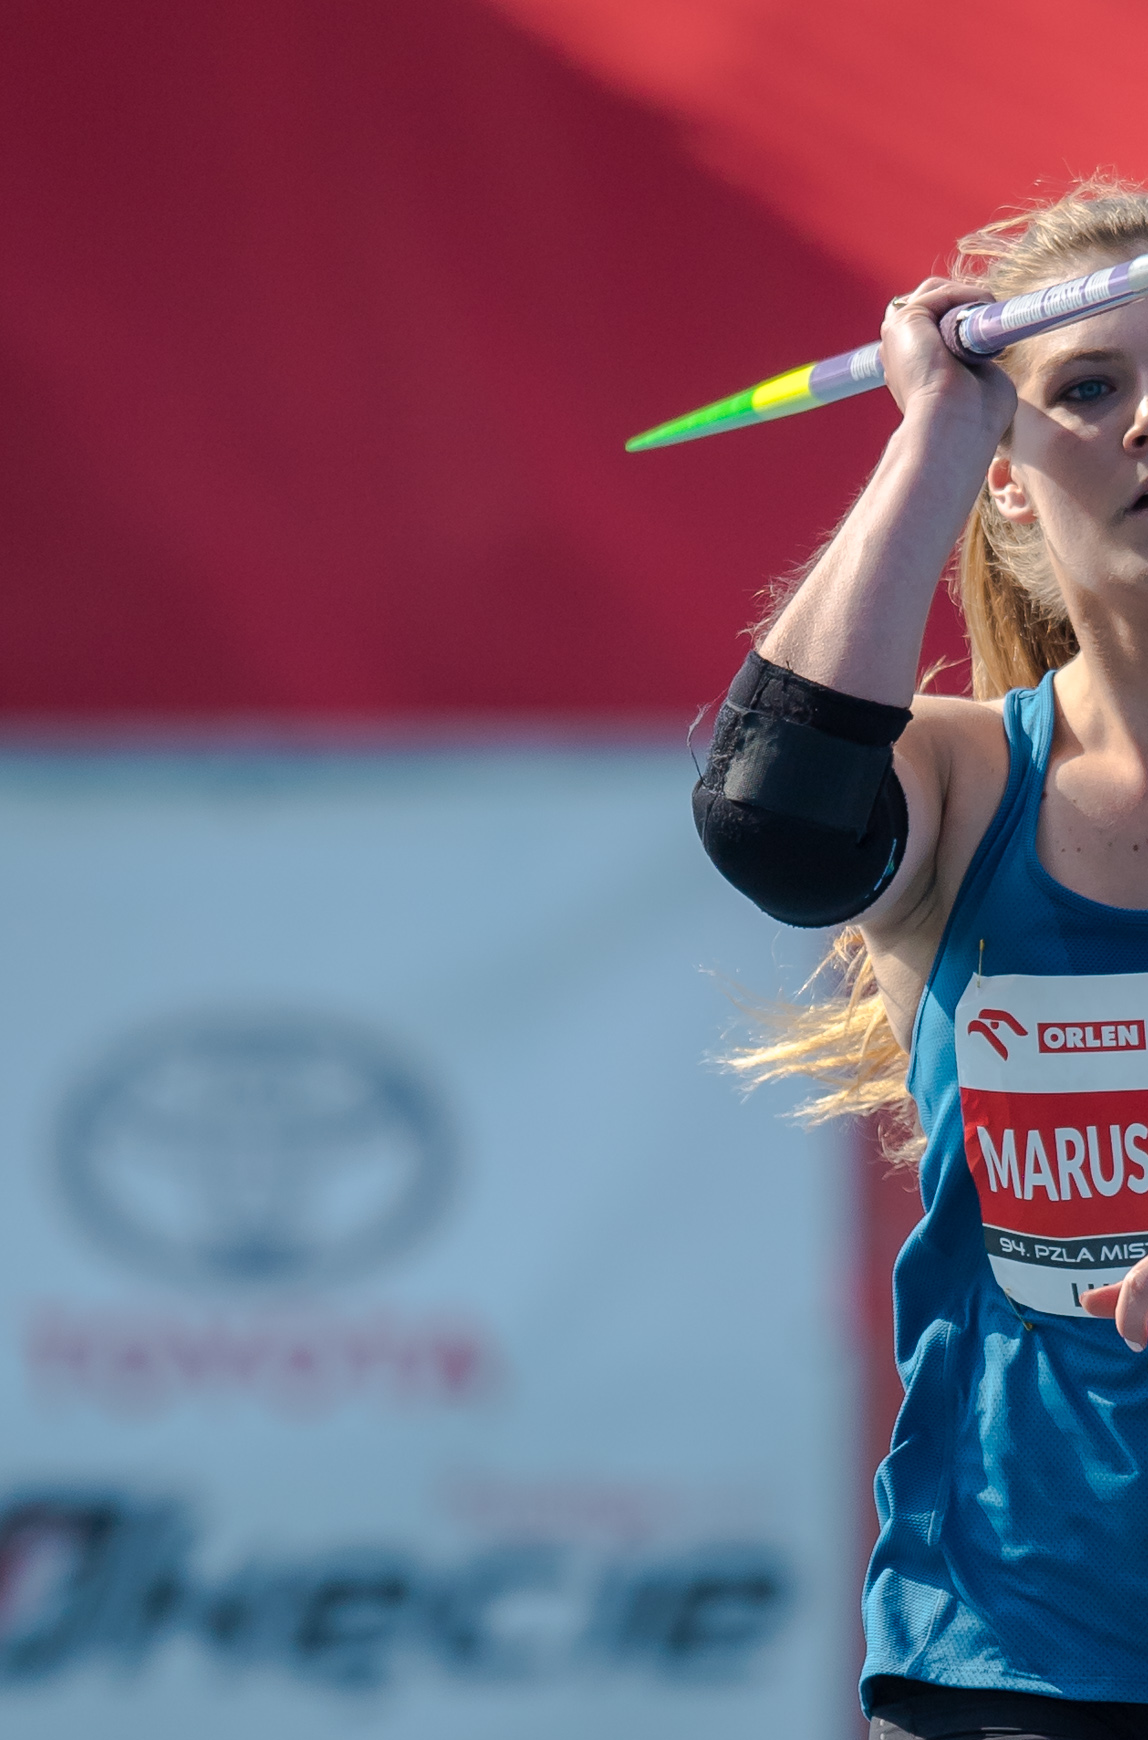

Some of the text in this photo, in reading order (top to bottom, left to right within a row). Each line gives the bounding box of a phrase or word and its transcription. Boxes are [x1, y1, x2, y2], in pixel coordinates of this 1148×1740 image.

[1043, 1024, 1140, 1050] ORLEN
[999, 1237, 1031, 1258] 94.
[1034, 1244, 1095, 1263] PZLA
